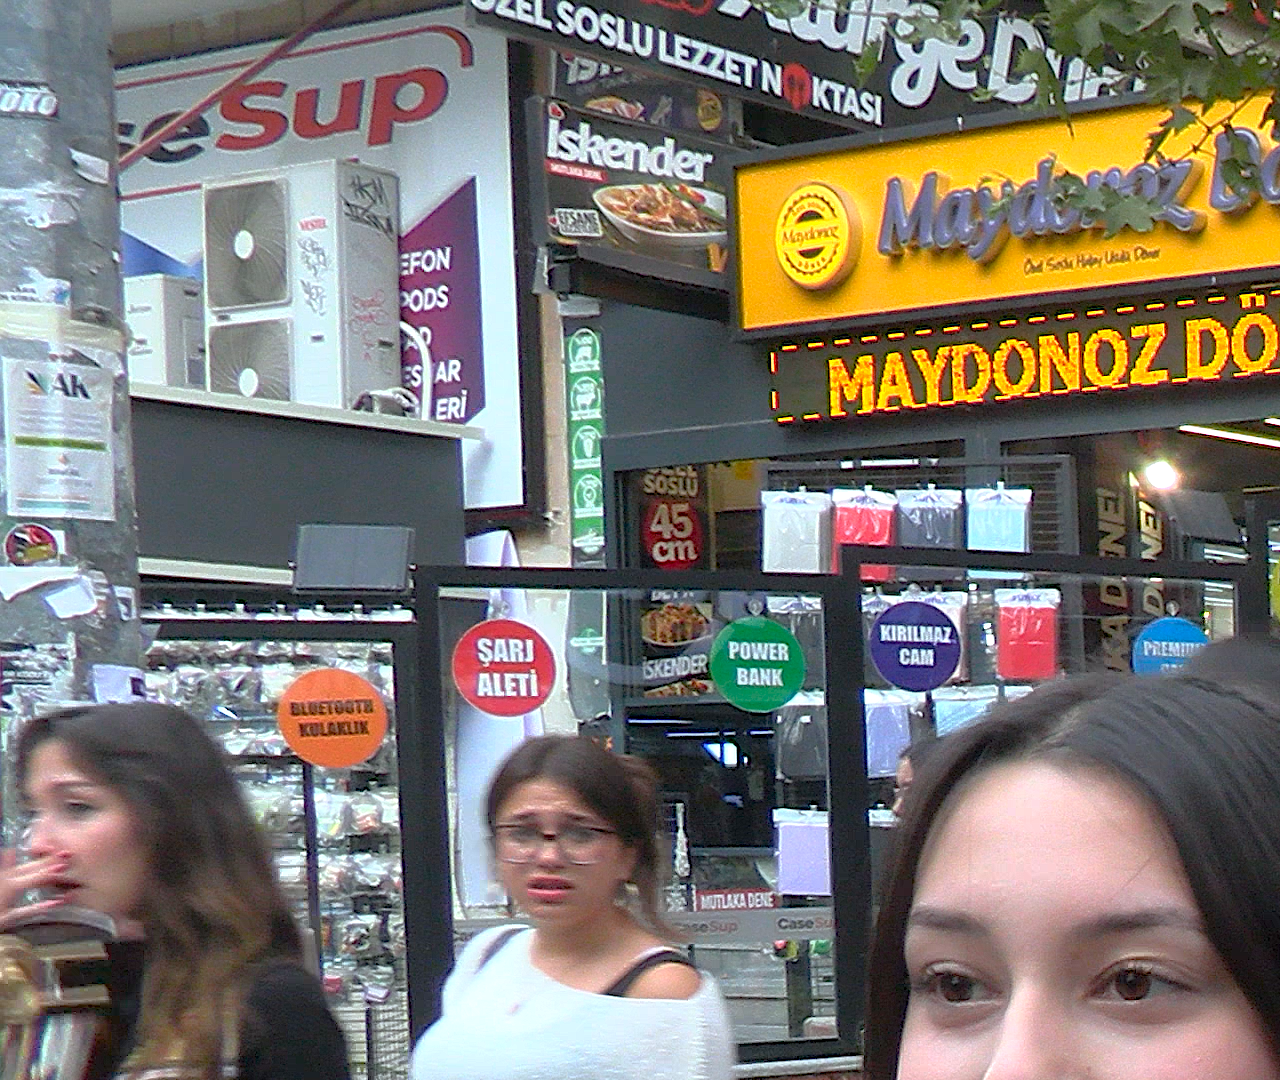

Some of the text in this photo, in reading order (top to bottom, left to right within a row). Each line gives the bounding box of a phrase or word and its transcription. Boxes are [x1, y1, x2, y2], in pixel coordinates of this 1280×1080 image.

[556, 1, 653, 57] SOSLU
[658, 28, 757, 88] LEZZET
[828, 322, 1169, 417] MAYDONOZ
[650, 502, 694, 539] 45
[652, 539, 698, 563] cm
[880, 624, 953, 645] KIRILMAZ
[477, 637, 535, 668] ŞARJ
[728, 641, 790, 661] POWER
[899, 648, 934, 667] CAM
[477, 669, 539, 697] ALETİ
[736, 666, 784, 688] BANK
[290, 699, 375, 717] BLUETOOTH
[299, 720, 369, 738] KULAKLIK
[700, 891, 774, 910] MUTLAKA DENE
